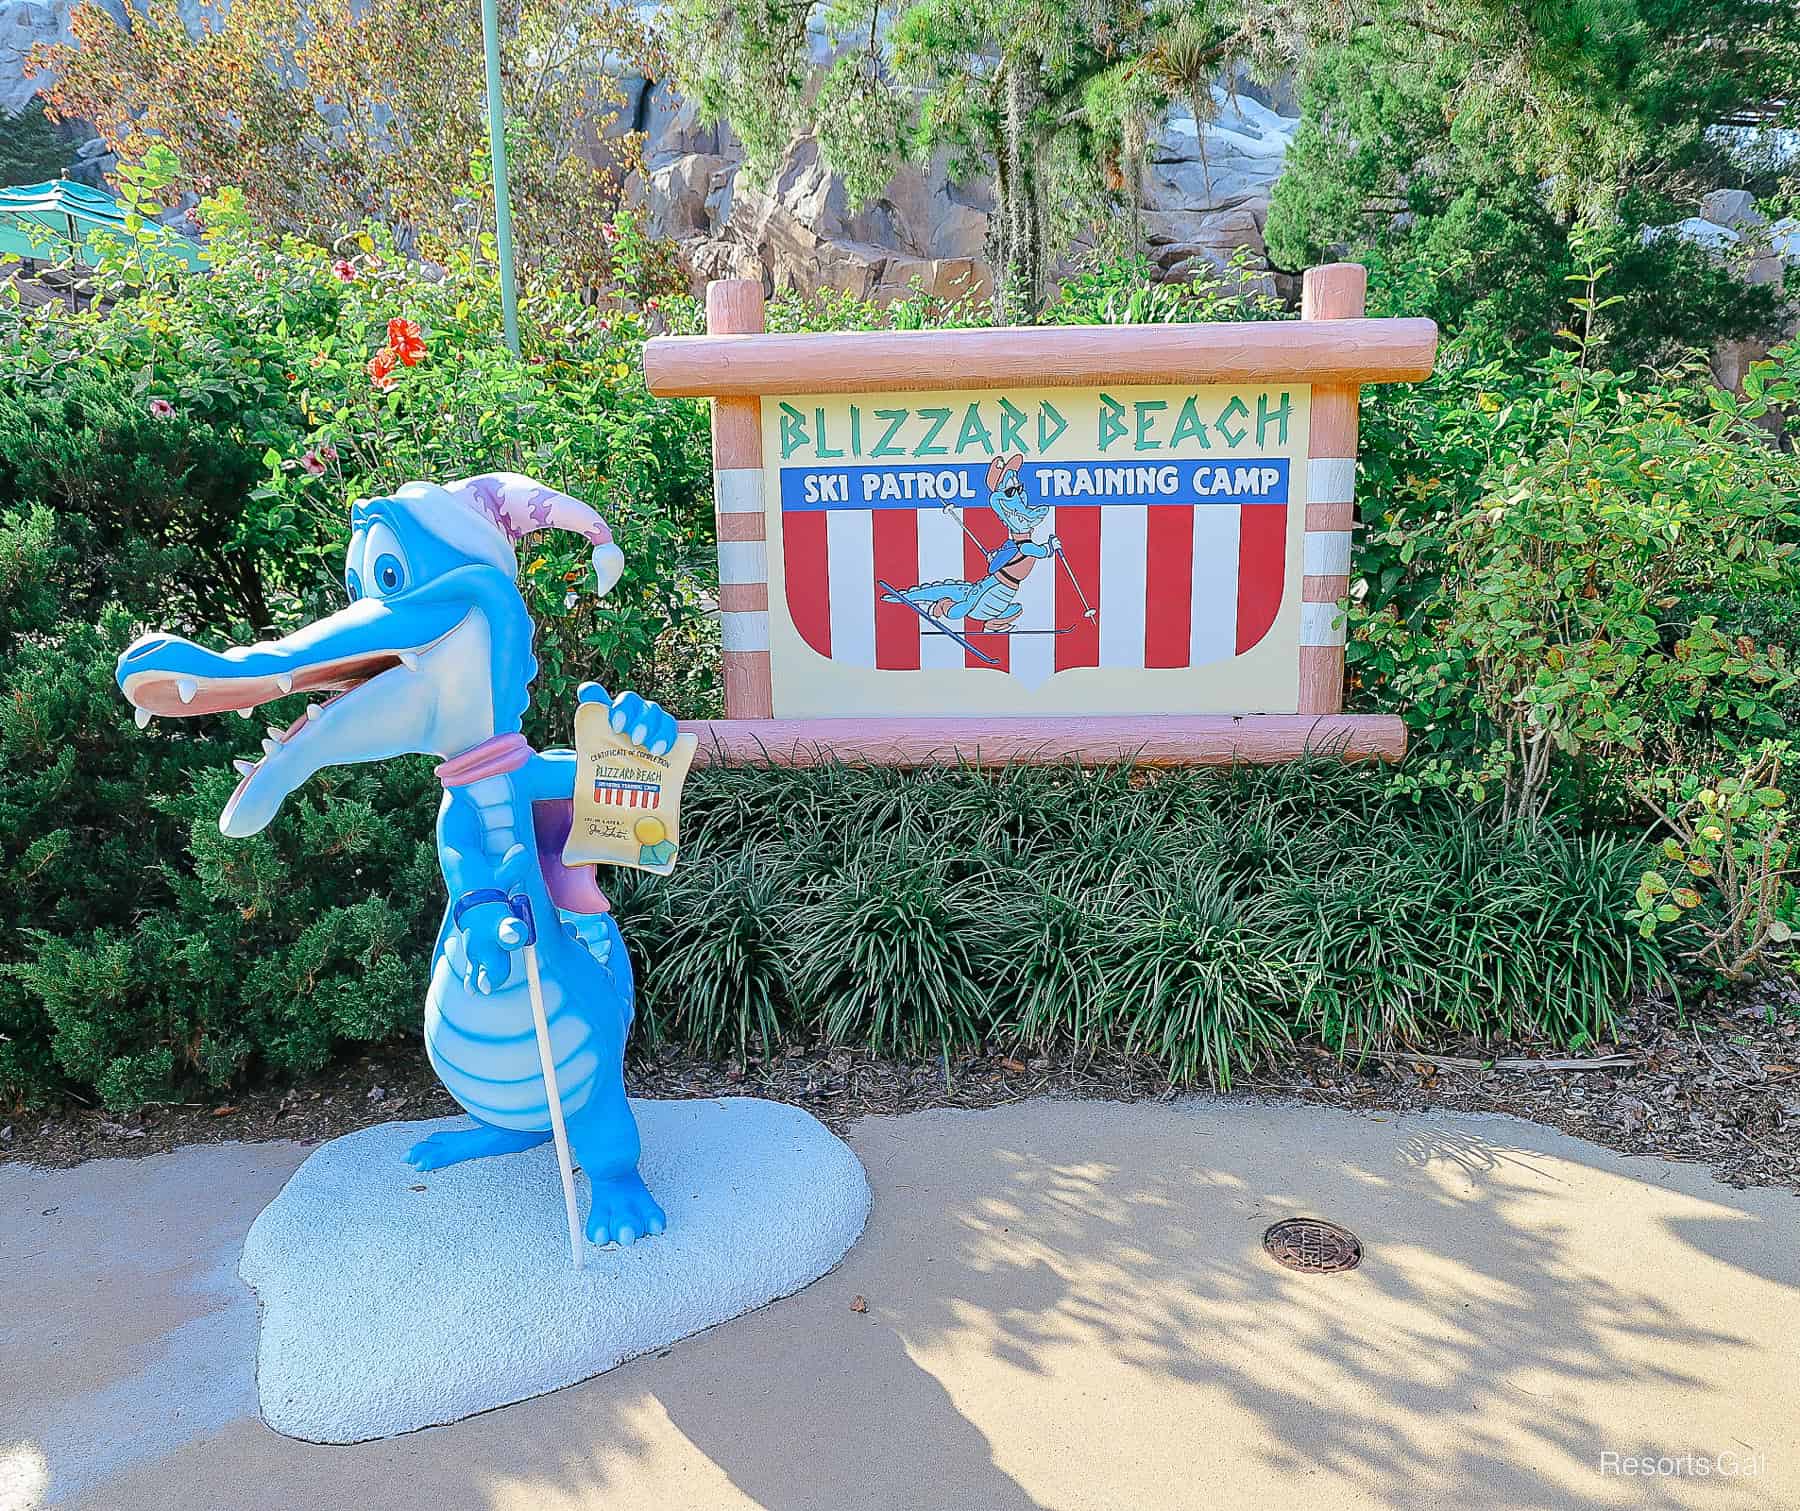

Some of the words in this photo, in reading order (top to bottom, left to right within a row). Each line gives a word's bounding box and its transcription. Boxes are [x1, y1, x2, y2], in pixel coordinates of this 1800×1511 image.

[779, 397, 1068, 458] BLIZZARD
[1098, 391, 1295, 452] BEACH
[804, 473, 849, 504] SKI
[862, 469, 976, 502] PATROL
[1035, 465, 1178, 497] TRAINING
[1192, 466, 1280, 497] CAMP
[636, 767, 663, 782] BEACH
